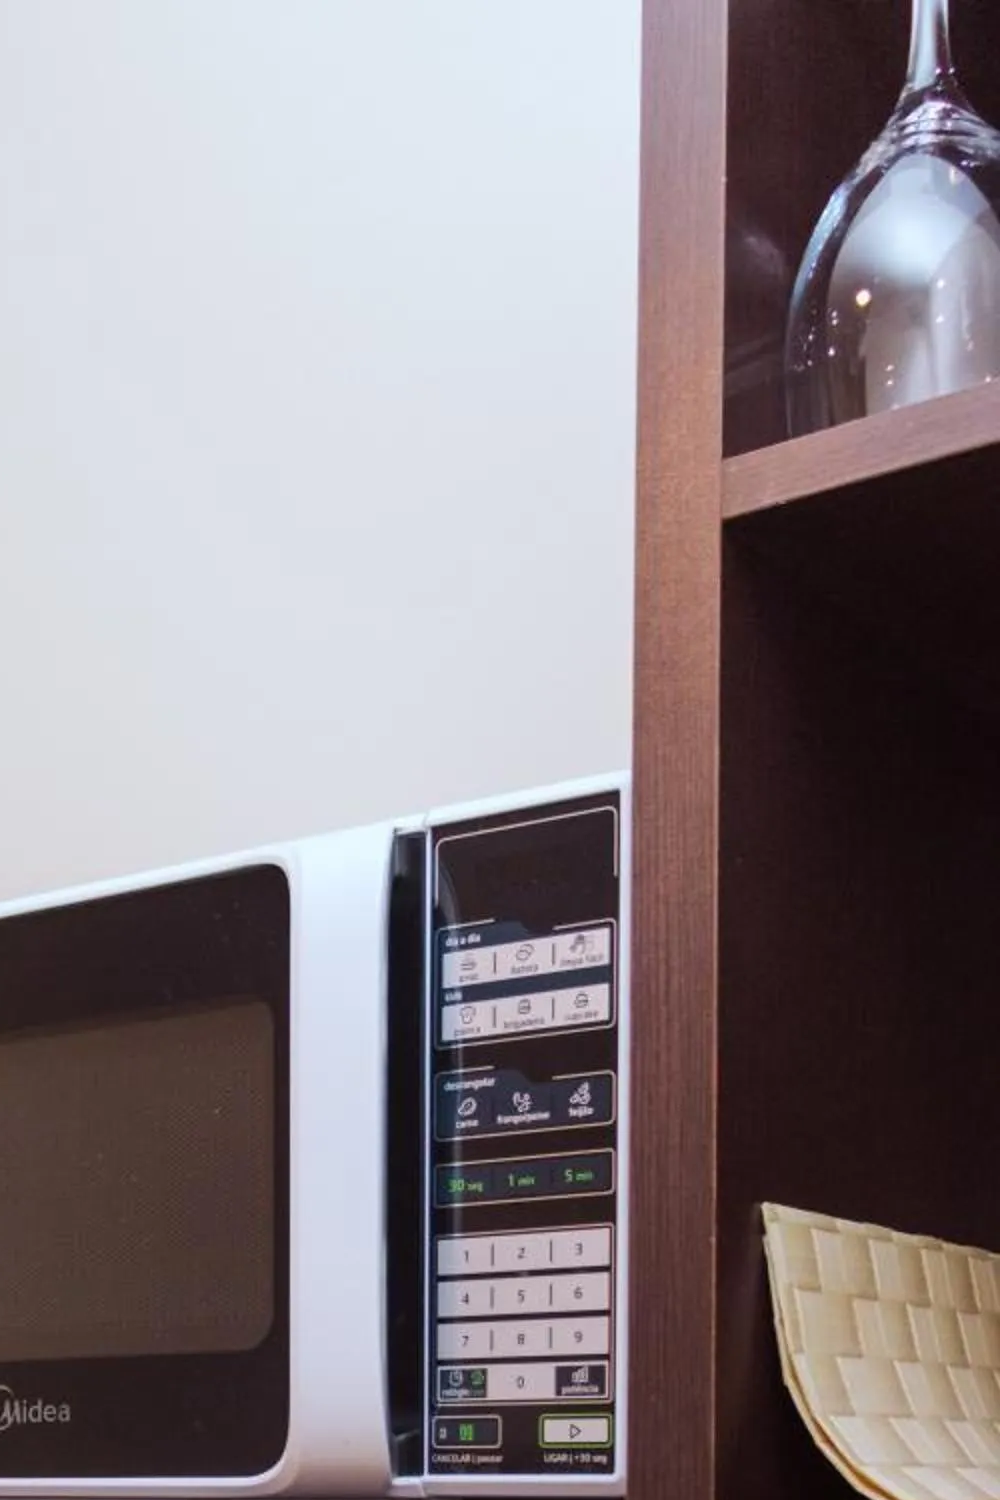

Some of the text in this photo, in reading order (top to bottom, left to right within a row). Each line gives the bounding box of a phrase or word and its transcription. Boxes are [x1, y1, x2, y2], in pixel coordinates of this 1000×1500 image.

[564, 1169, 573, 1182] 5
[463, 1243, 584, 1263] 1 2 3
[461, 1286, 583, 1304] 4 5 6
[461, 1331, 583, 1347] 7 8 9
[515, 1375, 525, 1389] 0
[0, 1399, 71, 1424] Midea
